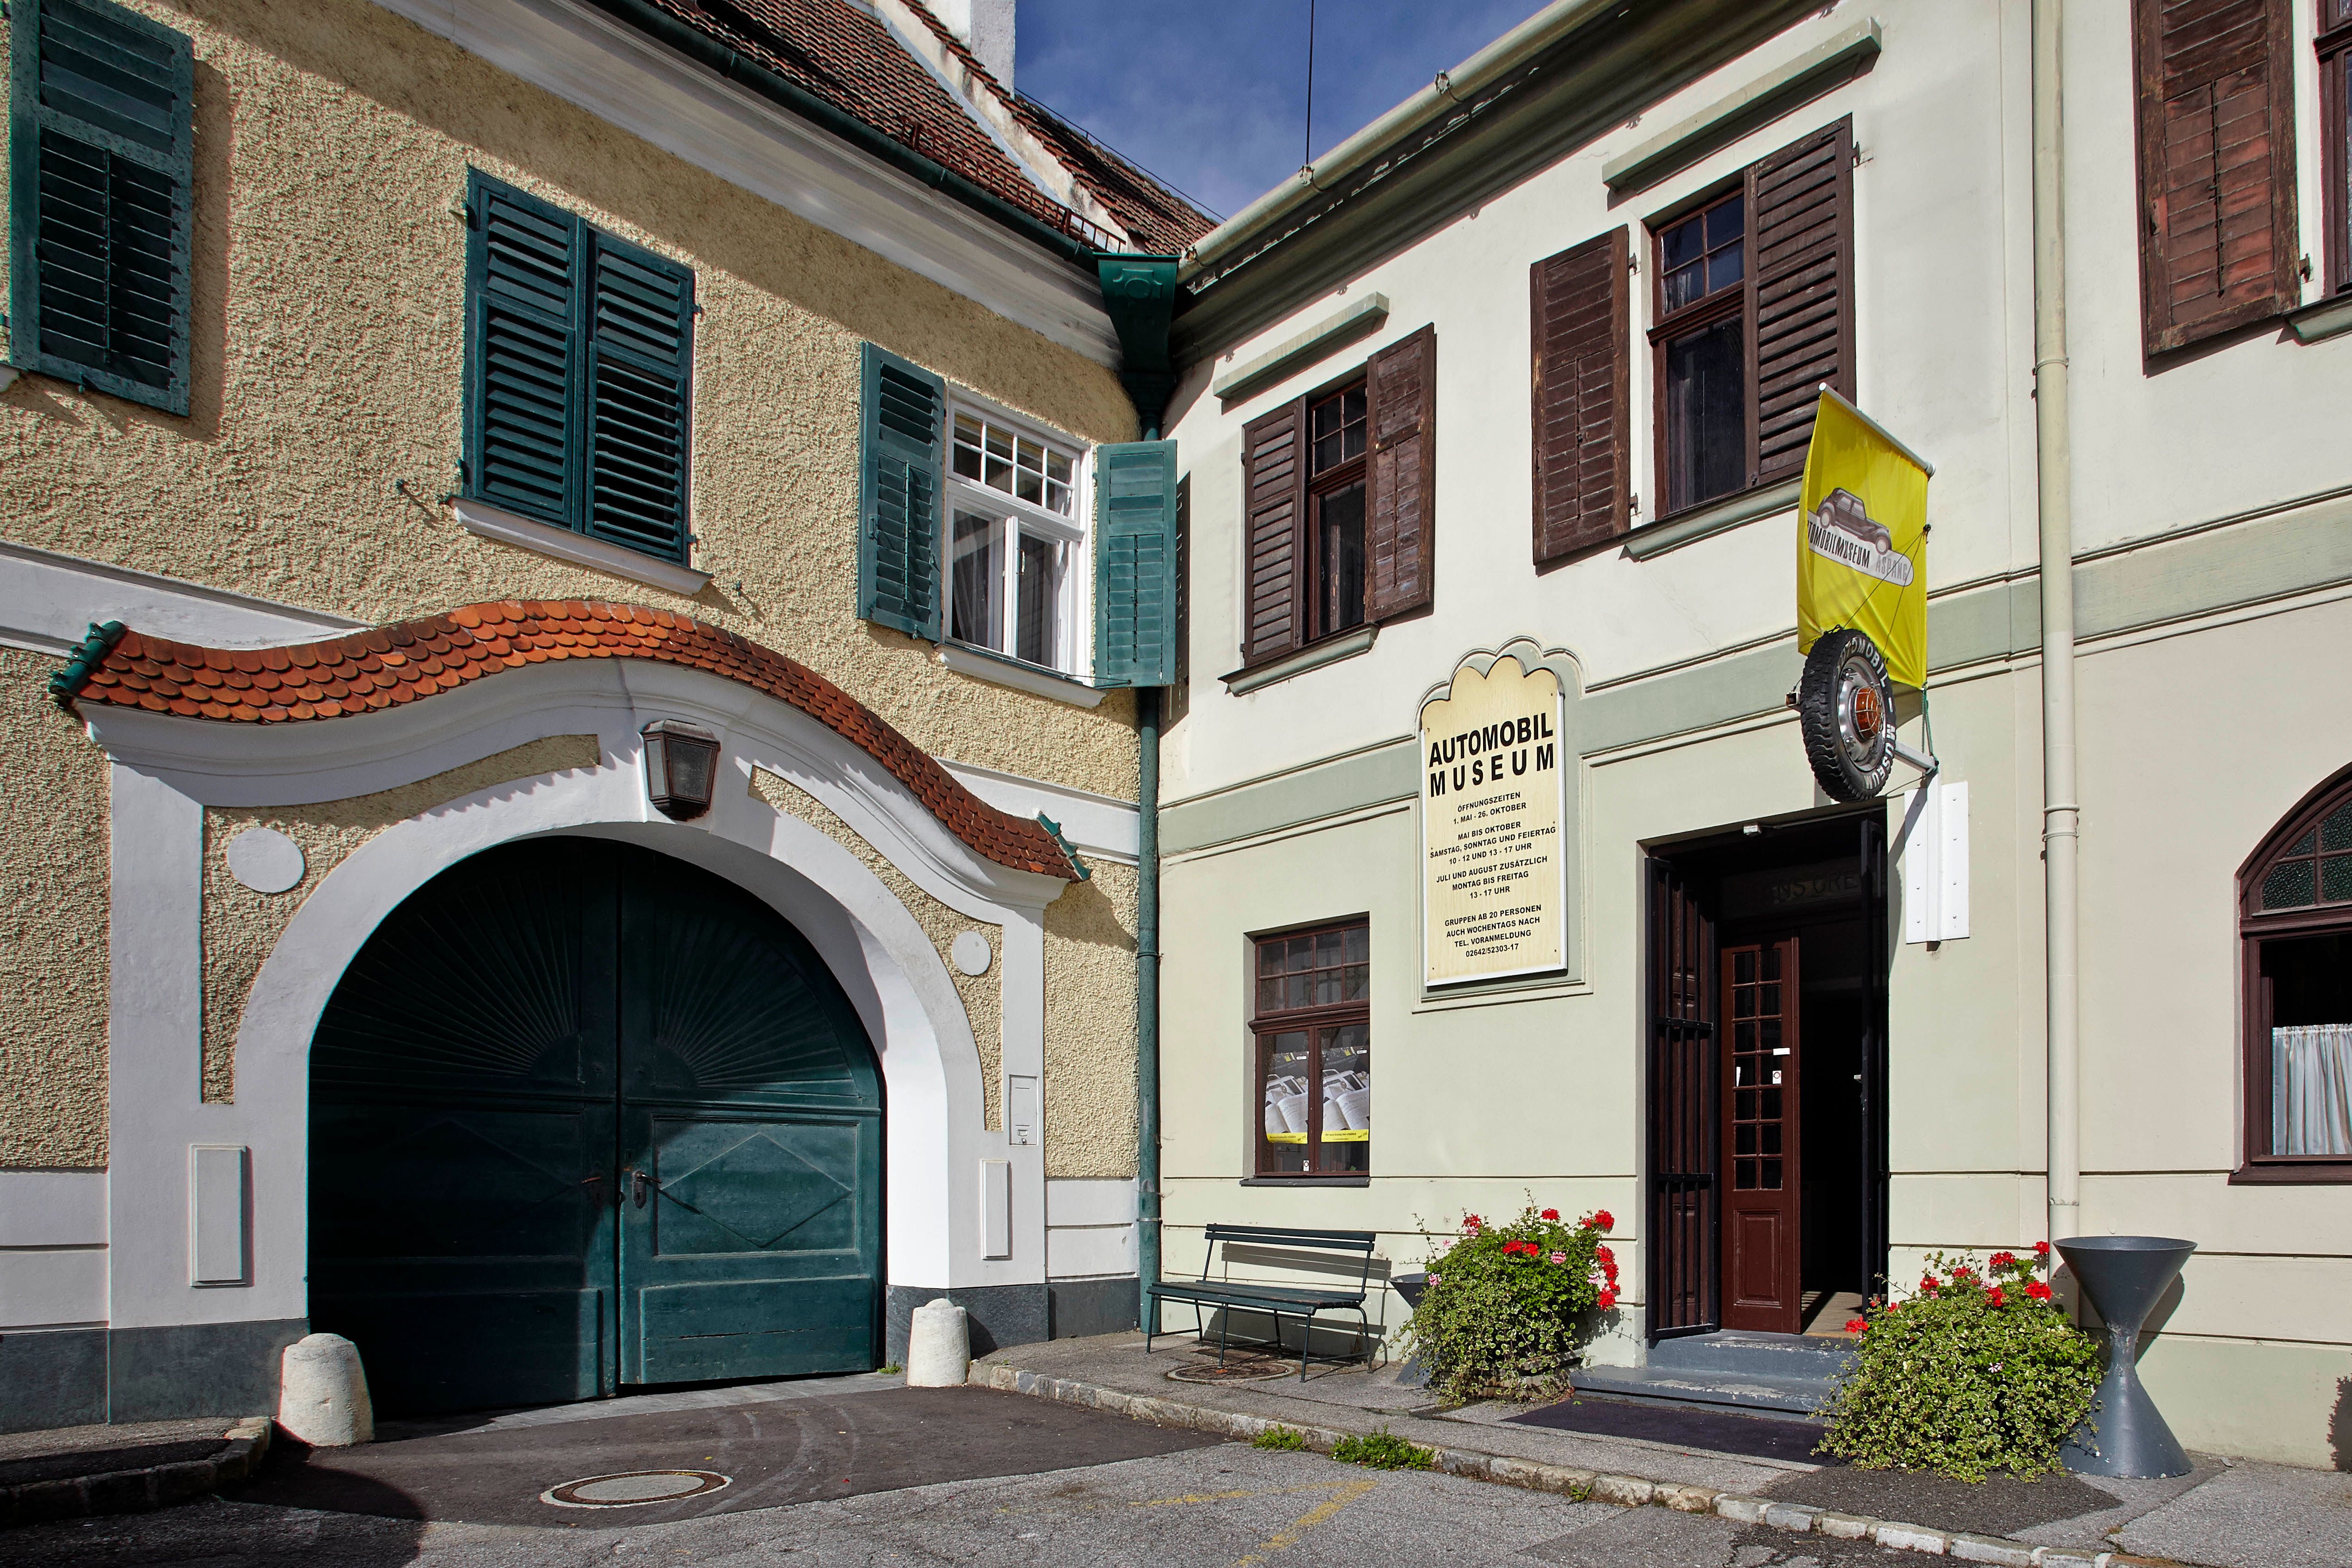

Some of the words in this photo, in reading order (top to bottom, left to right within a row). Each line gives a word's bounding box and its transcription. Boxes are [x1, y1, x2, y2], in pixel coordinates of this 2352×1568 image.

[1807, 520, 1870, 569] TOMOBILMUSEUM
[1875, 556, 1908, 581] ASPANG
[1429, 712, 1553, 768] AUTOMOBIL
[1864, 724, 1896, 789] MUSEUM
[1430, 743, 1553, 798] MUSEUM
[1458, 791, 1521, 812] ÖFFNUNGSZEITEN
[1460, 814, 1472, 823] MAI
[1490, 802, 1527, 815] OKTOBER
[1458, 832, 1470, 841] MAI
[1472, 829, 1483, 837] BIS
[1484, 821, 1521, 834] OKTOBER
[1430, 845, 1462, 859] SAMSTAG,
[1464, 837, 1497, 850] SONNTAG
[1499, 834, 1515, 843] UND
[1518, 826, 1556, 840] FEIERTAG
[1472, 851, 1487, 860] UND
[1515, 842, 1532, 851] UHR
[1436, 874, 1451, 883] JULI
[1453, 871, 1467, 879] UND
[1468, 864, 1498, 876] AUGUST
[1499, 855, 1547, 870] ZUSÄTZLICH
[1452, 879, 1481, 891] MONTAG
[1483, 877, 1495, 885] BIS
[1497, 871, 1529, 882] FREITAG
[1494, 885, 1510, 894] UHR
[1445, 915, 1476, 927] GRUPPEN
[1500, 904, 1541, 917] PERSONEN
[1446, 928, 1465, 938] AUCH
[1466, 920, 1516, 934] WOCHENTAGS
[1518, 916, 1540, 926] NACH
[1471, 929, 1531, 945] VORANMELDUNG
[1465, 943, 1519, 957] 02642/52303-17
